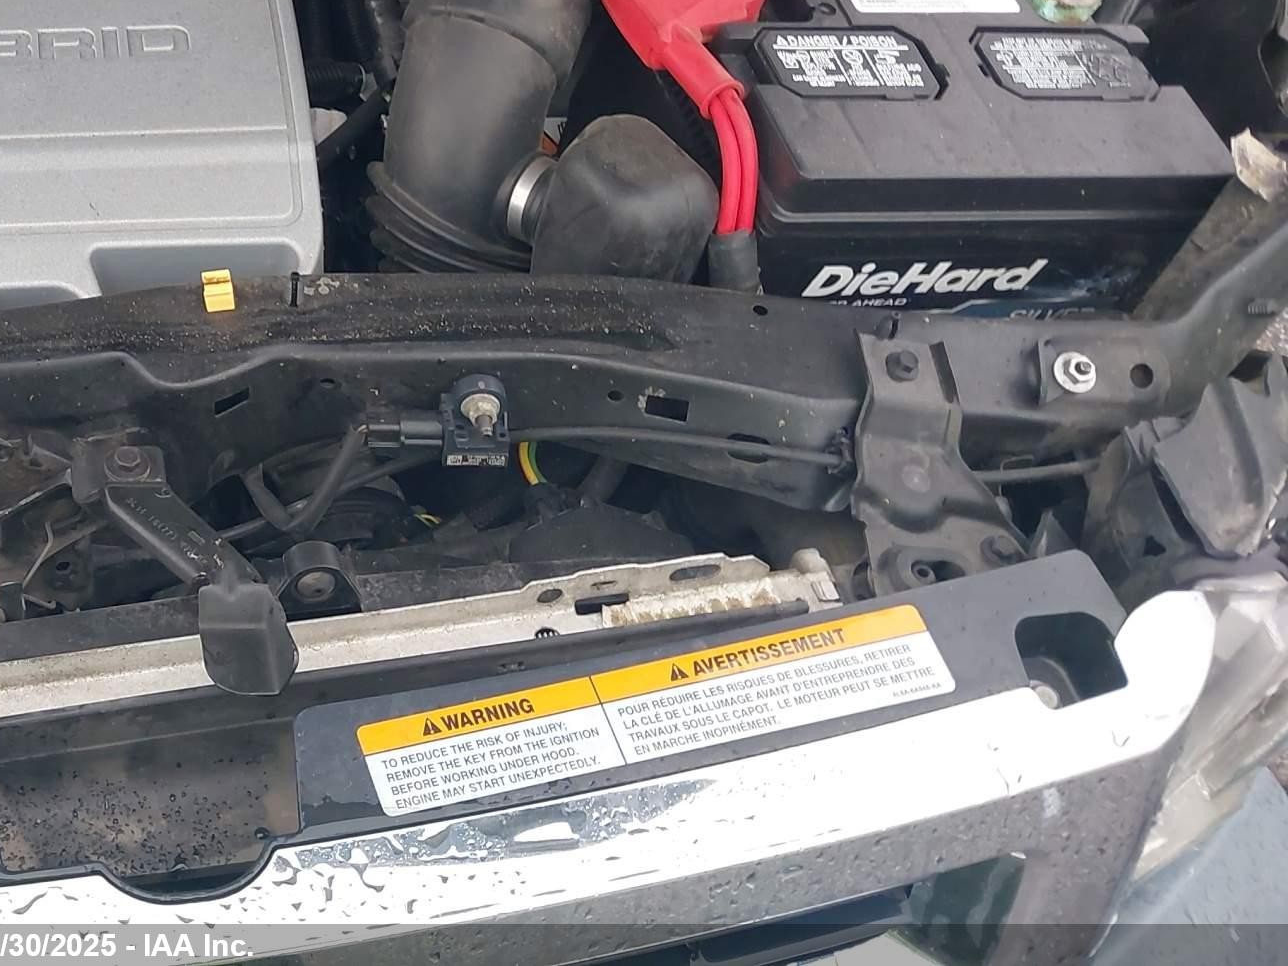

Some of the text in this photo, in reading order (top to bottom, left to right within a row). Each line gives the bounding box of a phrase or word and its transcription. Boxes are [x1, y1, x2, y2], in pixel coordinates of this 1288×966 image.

[787, 35, 840, 47] DANGER
[850, 35, 897, 47] POISON
[801, 258, 1049, 298] DieHard
[852, 298, 908, 307] AHEAD
[688, 627, 848, 676] AVERTISSEMENT
[616, 701, 650, 717] POUR
[701, 684, 726, 698] LES
[725, 673, 776, 693] RISQUES
[775, 669, 793, 682] DE
[862, 643, 912, 662] RETIRER
[622, 718, 640, 730] LA
[663, 708, 682, 721] DE
[681, 692, 754, 717] L'ALLUMAGE
[753, 683, 791, 700] AVANT
[791, 661, 891, 692] D'ENTREPRENDRE
[890, 655, 916, 670] DES
[440, 696, 535, 732] WARNING
[627, 722, 681, 743] TRAVAUX
[680, 714, 715, 731] SOUS
[714, 711, 731, 723] LE
[775, 697, 793, 710] LE
[792, 686, 841, 706] MOTEUR
[840, 679, 872, 695] PEUT
[871, 675, 889, 688] SE
[888, 665, 934, 684] METTRE
[380, 757, 399, 770] TO
[399, 746, 449, 766] REDUCE
[449, 740, 474, 755] THE
[474, 734, 503, 749] RISK
[503, 730, 522, 743] OF
[385, 726, 600, 783] REMOVE THE KEY FROM THE IGNITION
[633, 743, 651, 756] EN
[651, 731, 702, 751] MARCHE
[389, 776, 439, 796] BEFORE
[439, 763, 498, 785] WORKING
[498, 754, 540, 772] UNDER
[394, 790, 441, 809] ENGINE
[440, 784, 467, 799] MAY
[467, 775, 507, 793] START
